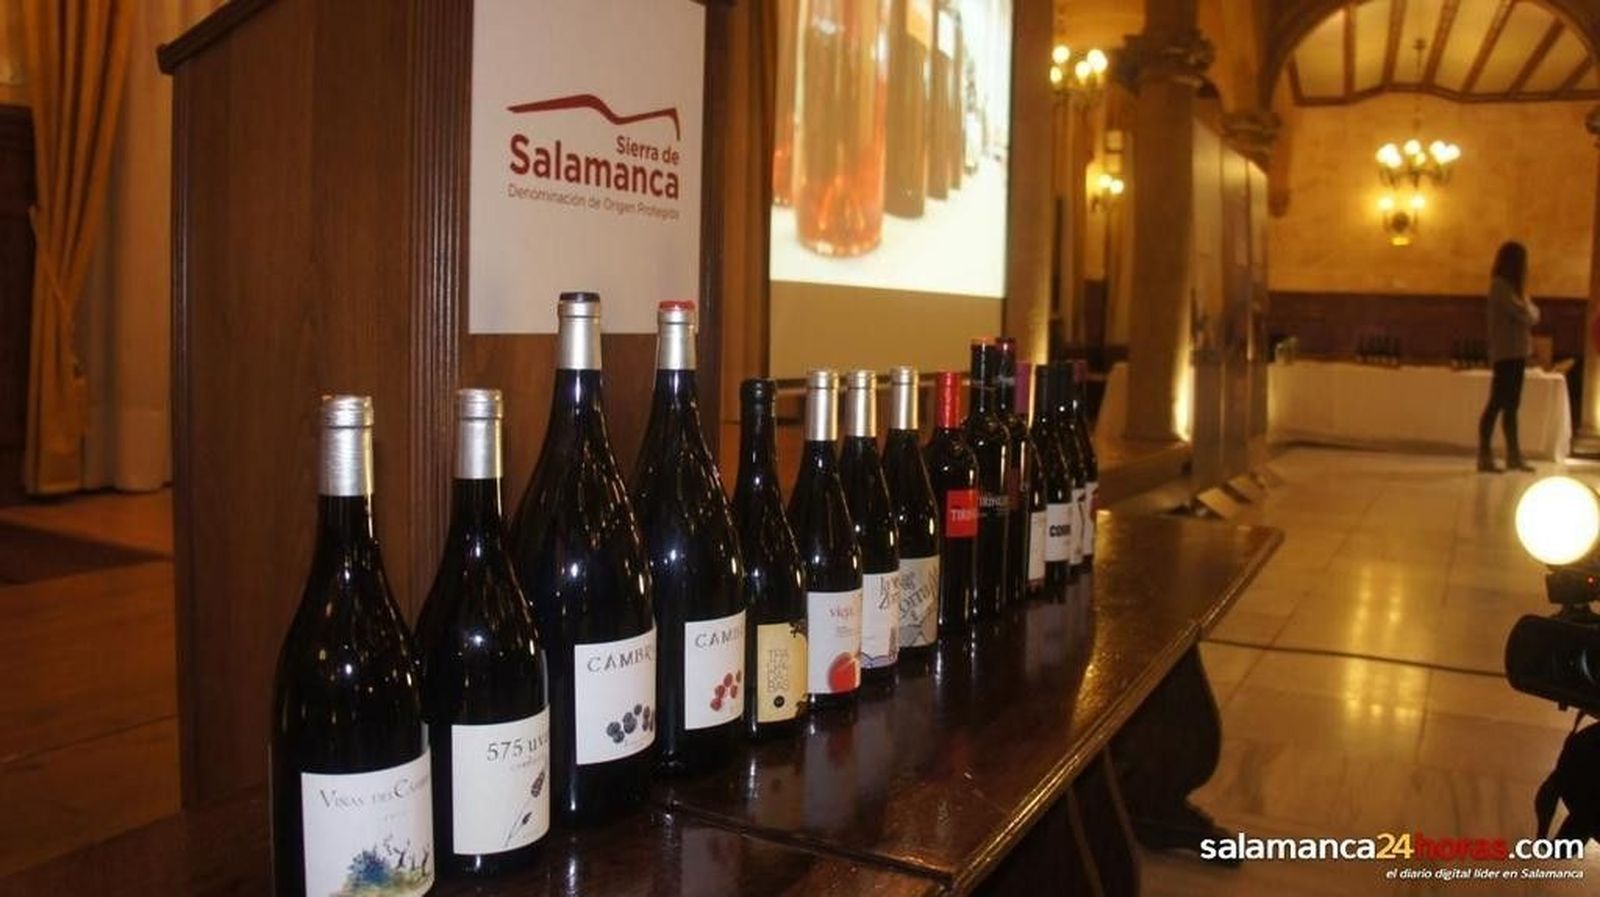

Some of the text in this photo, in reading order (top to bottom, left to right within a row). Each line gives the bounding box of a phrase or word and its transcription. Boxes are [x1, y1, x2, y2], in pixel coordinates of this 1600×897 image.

[616, 135, 680, 166] Sierra de
[509, 133, 680, 200] Salamanca
[507, 184, 587, 207] Denominación
[588, 197, 601, 209] de
[603, 197, 636, 215] Origen
[486, 738, 523, 762] 575
